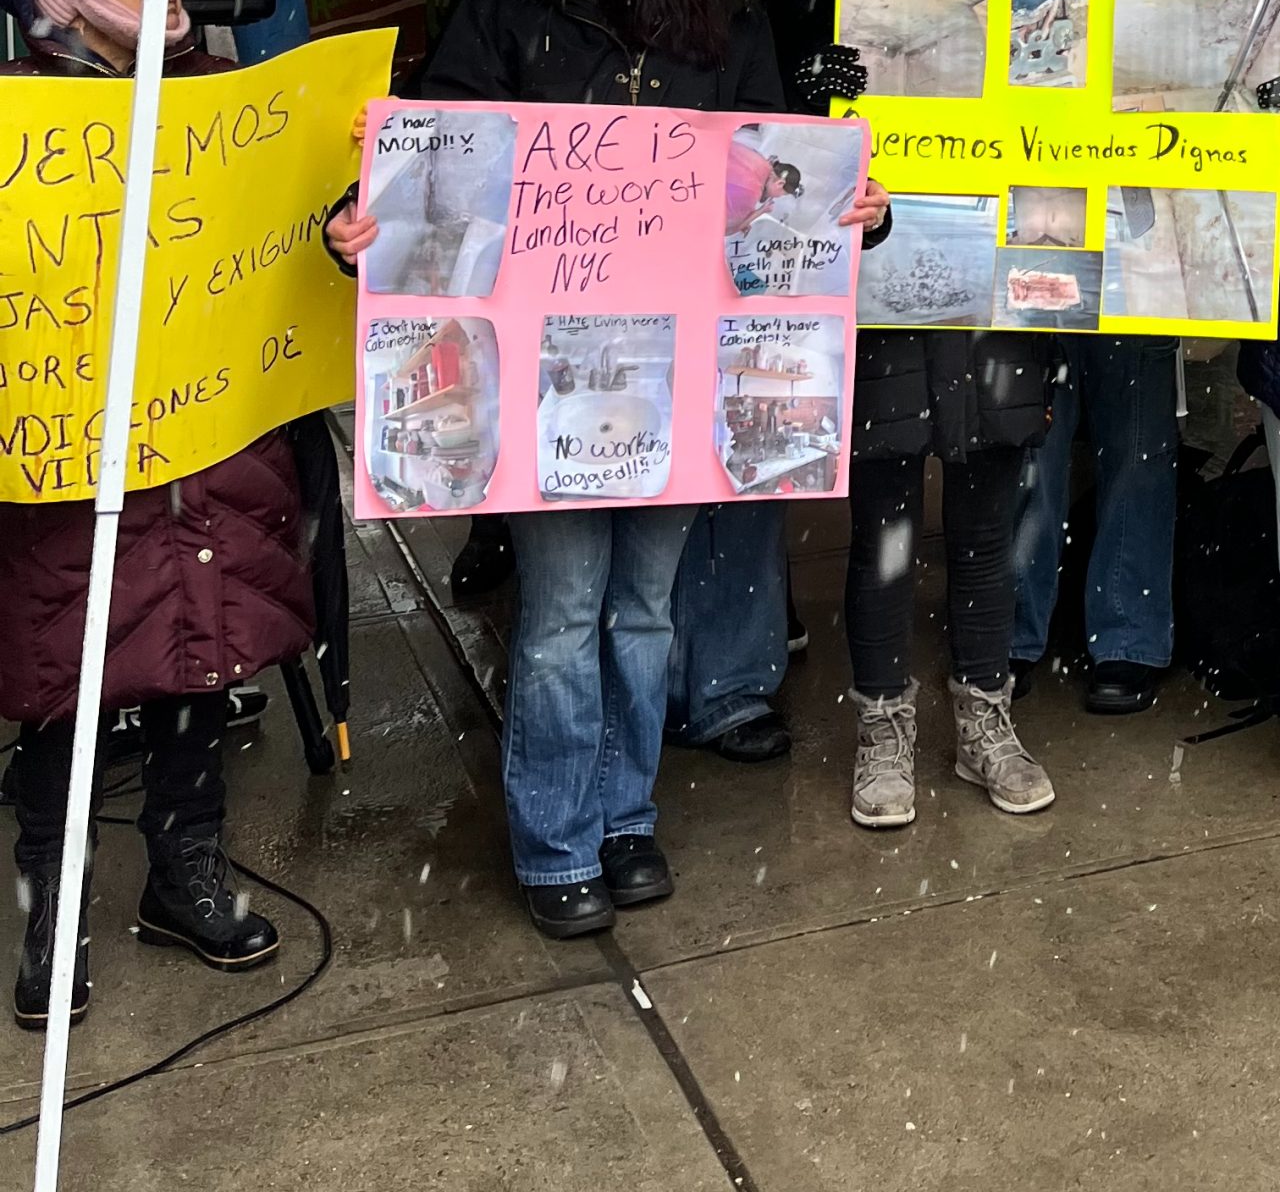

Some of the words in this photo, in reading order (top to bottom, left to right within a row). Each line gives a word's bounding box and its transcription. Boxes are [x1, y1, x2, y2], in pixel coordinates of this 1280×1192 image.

[381, 116, 394, 130] I
[402, 116, 436, 129] have
[522, 115, 628, 173] A&E
[850, 119, 1003, 159] ueremos
[1020, 125, 1138, 163] Viviendas
[1145, 122, 1248, 172] Dignas
[514, 180, 573, 218] The
[586, 171, 706, 206] worst
[511, 205, 619, 255] Landlord
[638, 208, 664, 237] in
[730, 240, 751, 258] I
[757, 237, 804, 254] wash
[782, 258, 795, 269] in
[802, 256, 826, 271] the
[551, 251, 613, 295] NYC
[369, 323, 379, 338] I
[546, 316, 553, 326] I
[558, 315, 589, 329] HATE
[723, 319, 740, 332] I
[786, 320, 821, 331] have
[261, 325, 303, 374] DE
